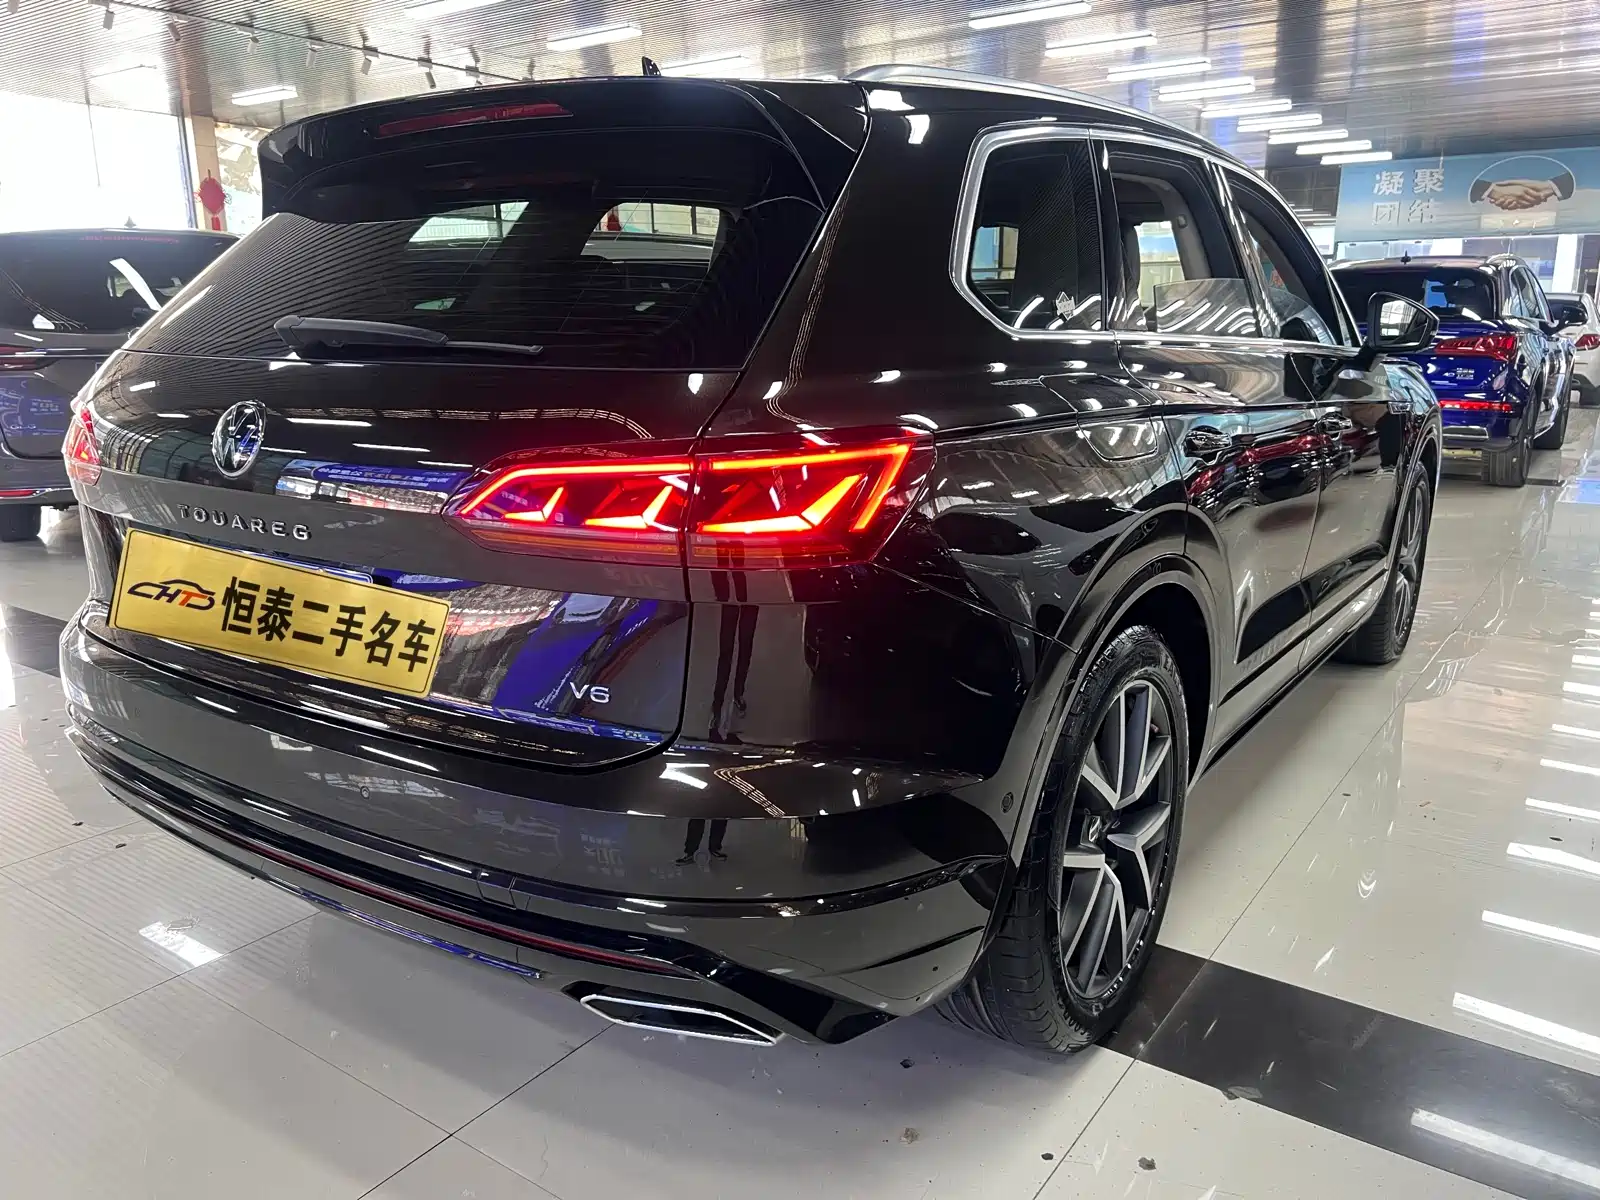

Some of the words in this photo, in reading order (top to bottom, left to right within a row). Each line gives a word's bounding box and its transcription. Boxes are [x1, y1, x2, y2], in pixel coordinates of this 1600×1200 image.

[1372, 168, 1445, 196] 凝聚
[1372, 198, 1444, 226] 团结
[176, 503, 313, 541] TOUAREG
[221, 576, 437, 673] 恒泰二手名车
[569, 681, 611, 704] V6
